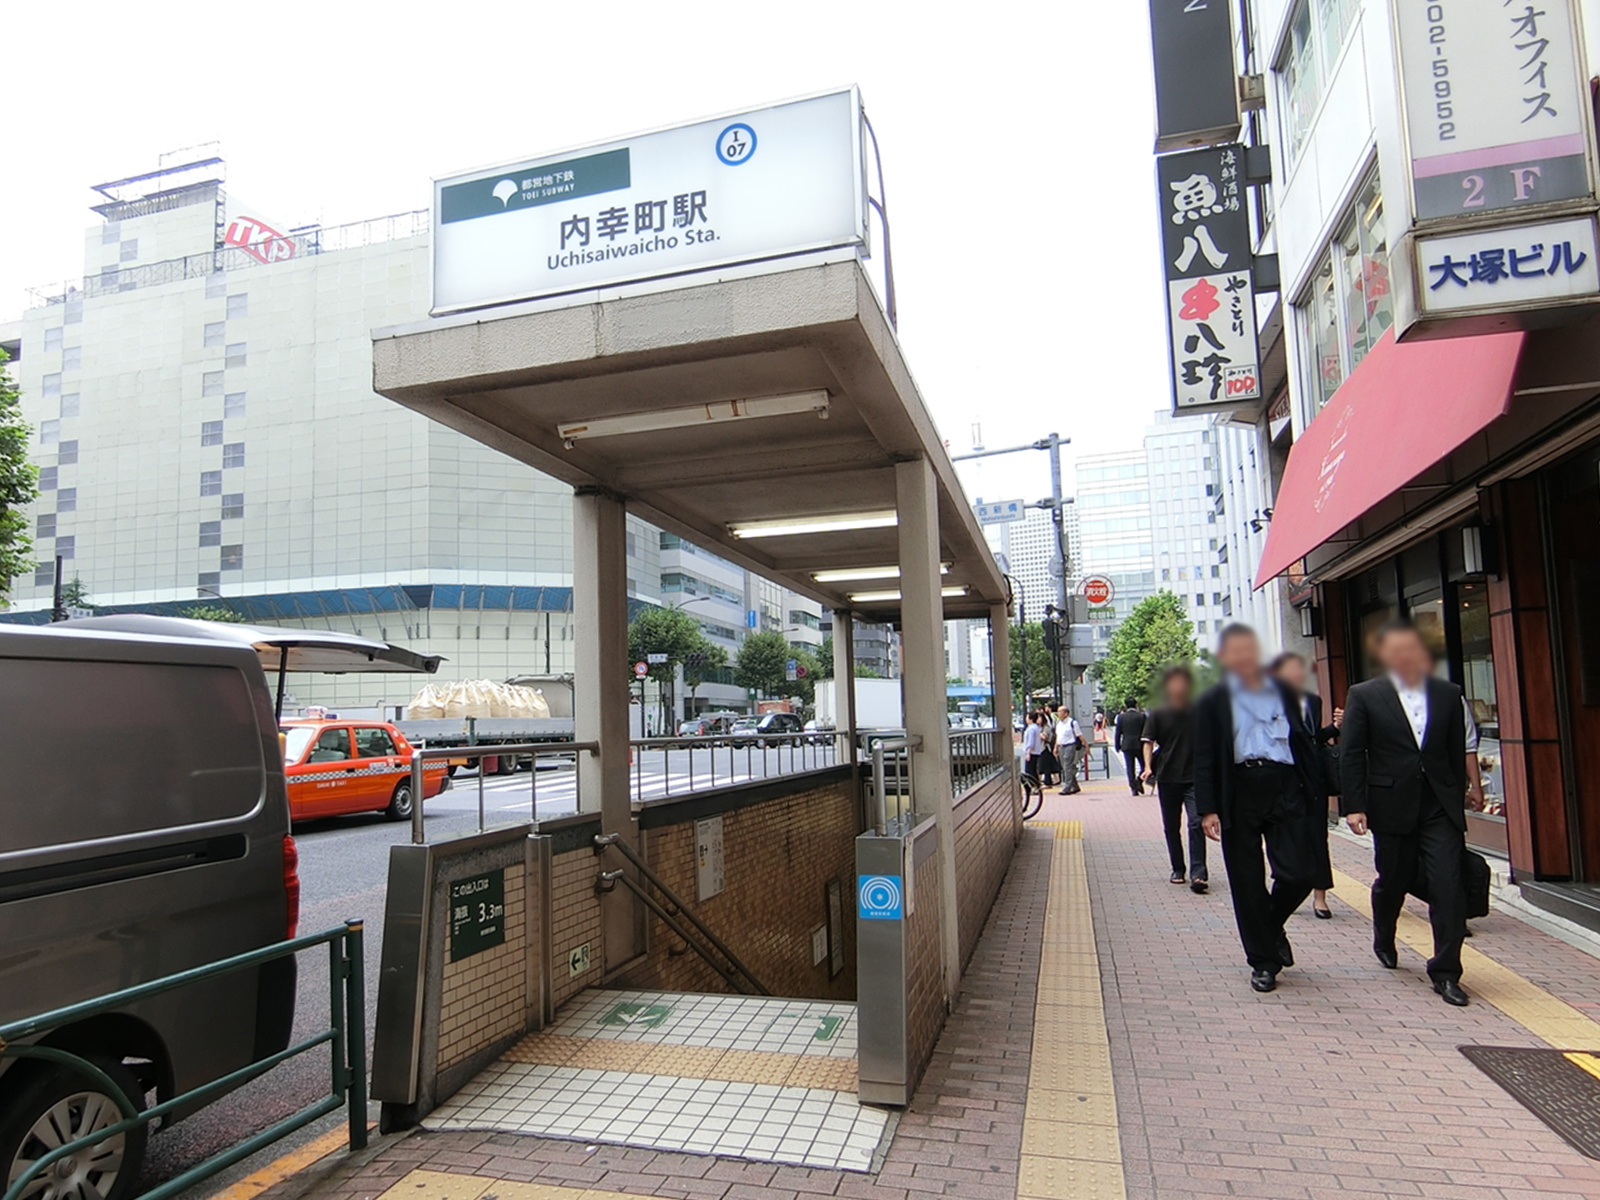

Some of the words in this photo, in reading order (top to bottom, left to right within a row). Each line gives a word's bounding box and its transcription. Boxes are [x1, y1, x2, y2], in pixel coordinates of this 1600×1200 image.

[1426, 0, 1456, 141] 02-5952
[1503, 0, 1558, 124] オフィス
[726, 141, 747, 158] 07
[732, 130, 740, 143] I
[521, 170, 575, 191] 都営地下鉄
[521, 190, 539, 201] TOEI
[541, 183, 575, 197] SUBWAY
[1220, 149, 1240, 212] 海鮮酒場
[560, 190, 708, 250] 内幸町駅
[1169, 173, 1229, 273] 魚八
[231, 216, 292, 263] TKP
[547, 235, 679, 270] Uchisaiwaicho
[685, 228, 721, 246] Sta.
[1429, 241, 1587, 291] 大塚ビル
[1226, 374, 1256, 396] 100
[978, 502, 1017, 516] 西新橋
[453, 879, 489, 898] この出入口は
[479, 902, 503, 923] 3.3m
